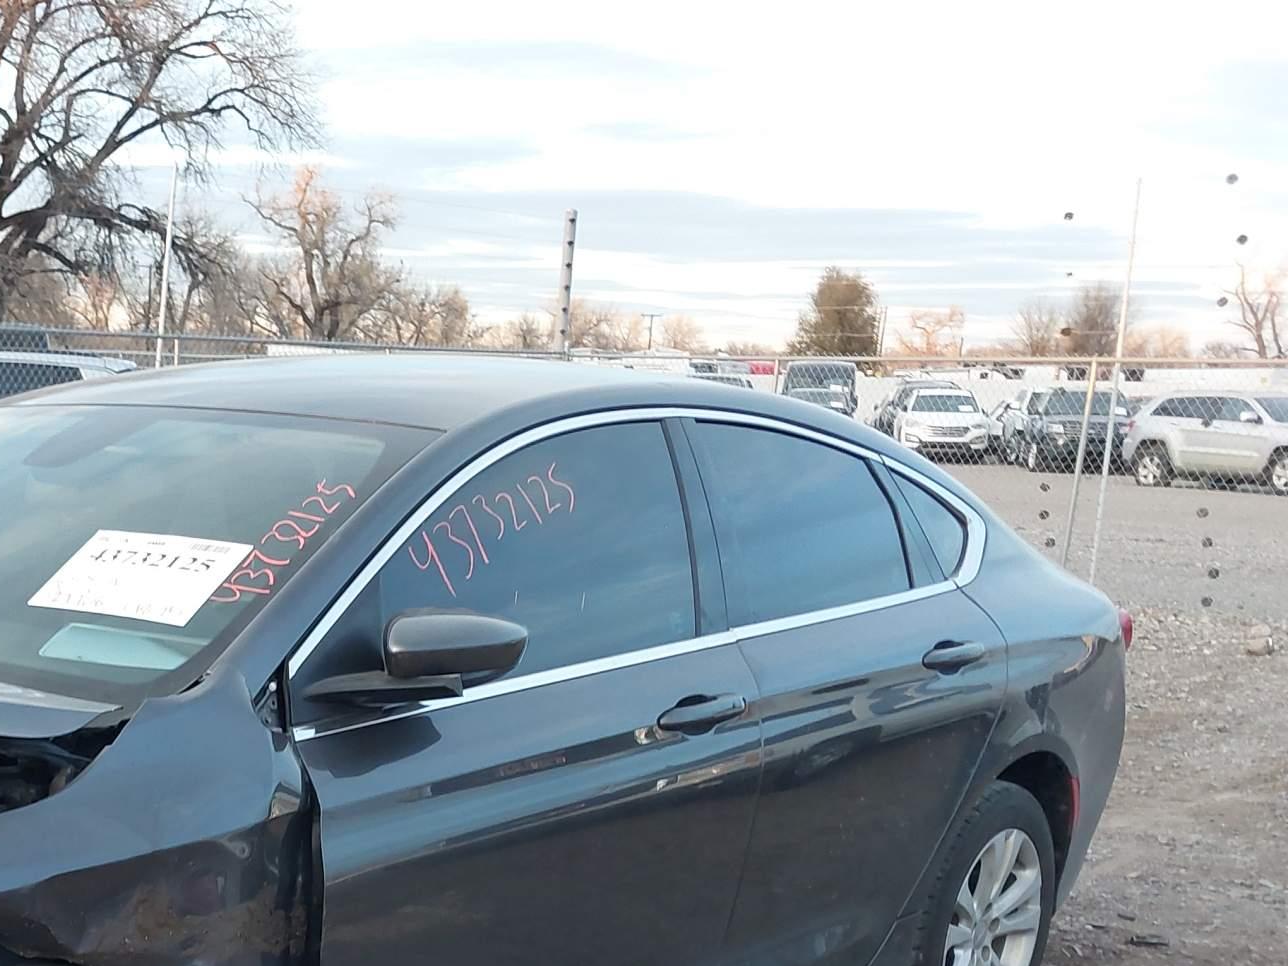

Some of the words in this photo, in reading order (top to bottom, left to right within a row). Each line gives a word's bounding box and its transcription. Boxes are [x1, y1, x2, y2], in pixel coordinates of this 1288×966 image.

[89, 548, 216, 573] 43732125
[211, 477, 356, 603] 43732125
[408, 461, 575, 598] 43732125
